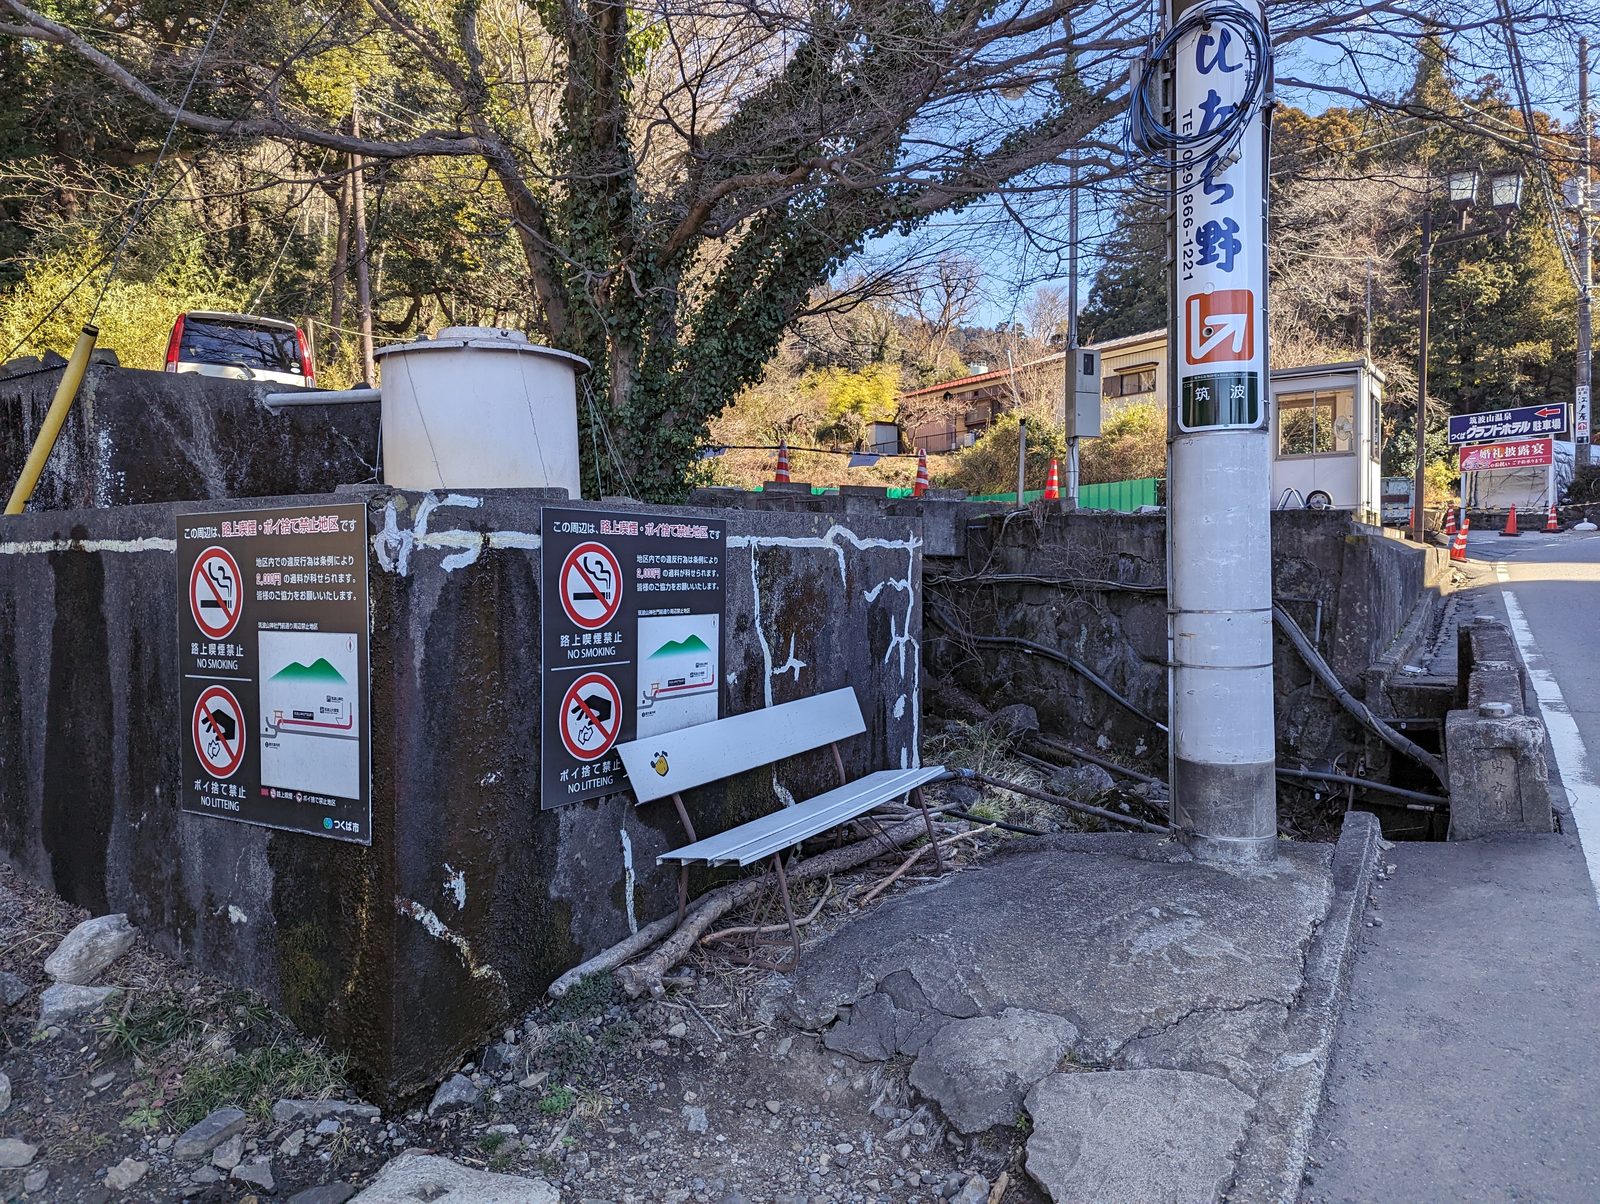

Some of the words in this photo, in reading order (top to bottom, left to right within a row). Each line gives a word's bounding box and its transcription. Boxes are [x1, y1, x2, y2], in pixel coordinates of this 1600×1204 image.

[1182, 149, 1194, 281] 029866-1221
[1194, 384, 1246, 402] 筑波
[1469, 412, 1512, 425] 筑波山温泉
[1532, 418, 1562, 432] 駐車場
[1468, 443, 1545, 460] ご婚礼披露宴
[255, 555, 354, 568] 地区内での違反行為は条例により
[636, 554, 719, 565] 地区内での違反行為は条例により
[636, 582, 720, 592] 皆様のご協力をお願いいたします。
[256, 590, 357, 601] 皆様のご協力をお願いいたします。
[560, 631, 623, 648] 路上喫煙禁止
[191, 642, 244, 657] 路上喫煙禁止
[567, 648, 580, 659] NO
[581, 646, 616, 658] SMOKING
[197, 658, 207, 669] NO
[207, 658, 238, 670] SMOKING
[560, 758, 621, 783] ポイ捨て禁止
[194, 779, 247, 799] ポイ捨て禁止
[567, 782, 580, 794] NO
[581, 775, 614, 792] LITTEING
[200, 796, 211, 807] NO
[212, 797, 240, 812] LITTEING
[333, 819, 360, 833] つくば市
